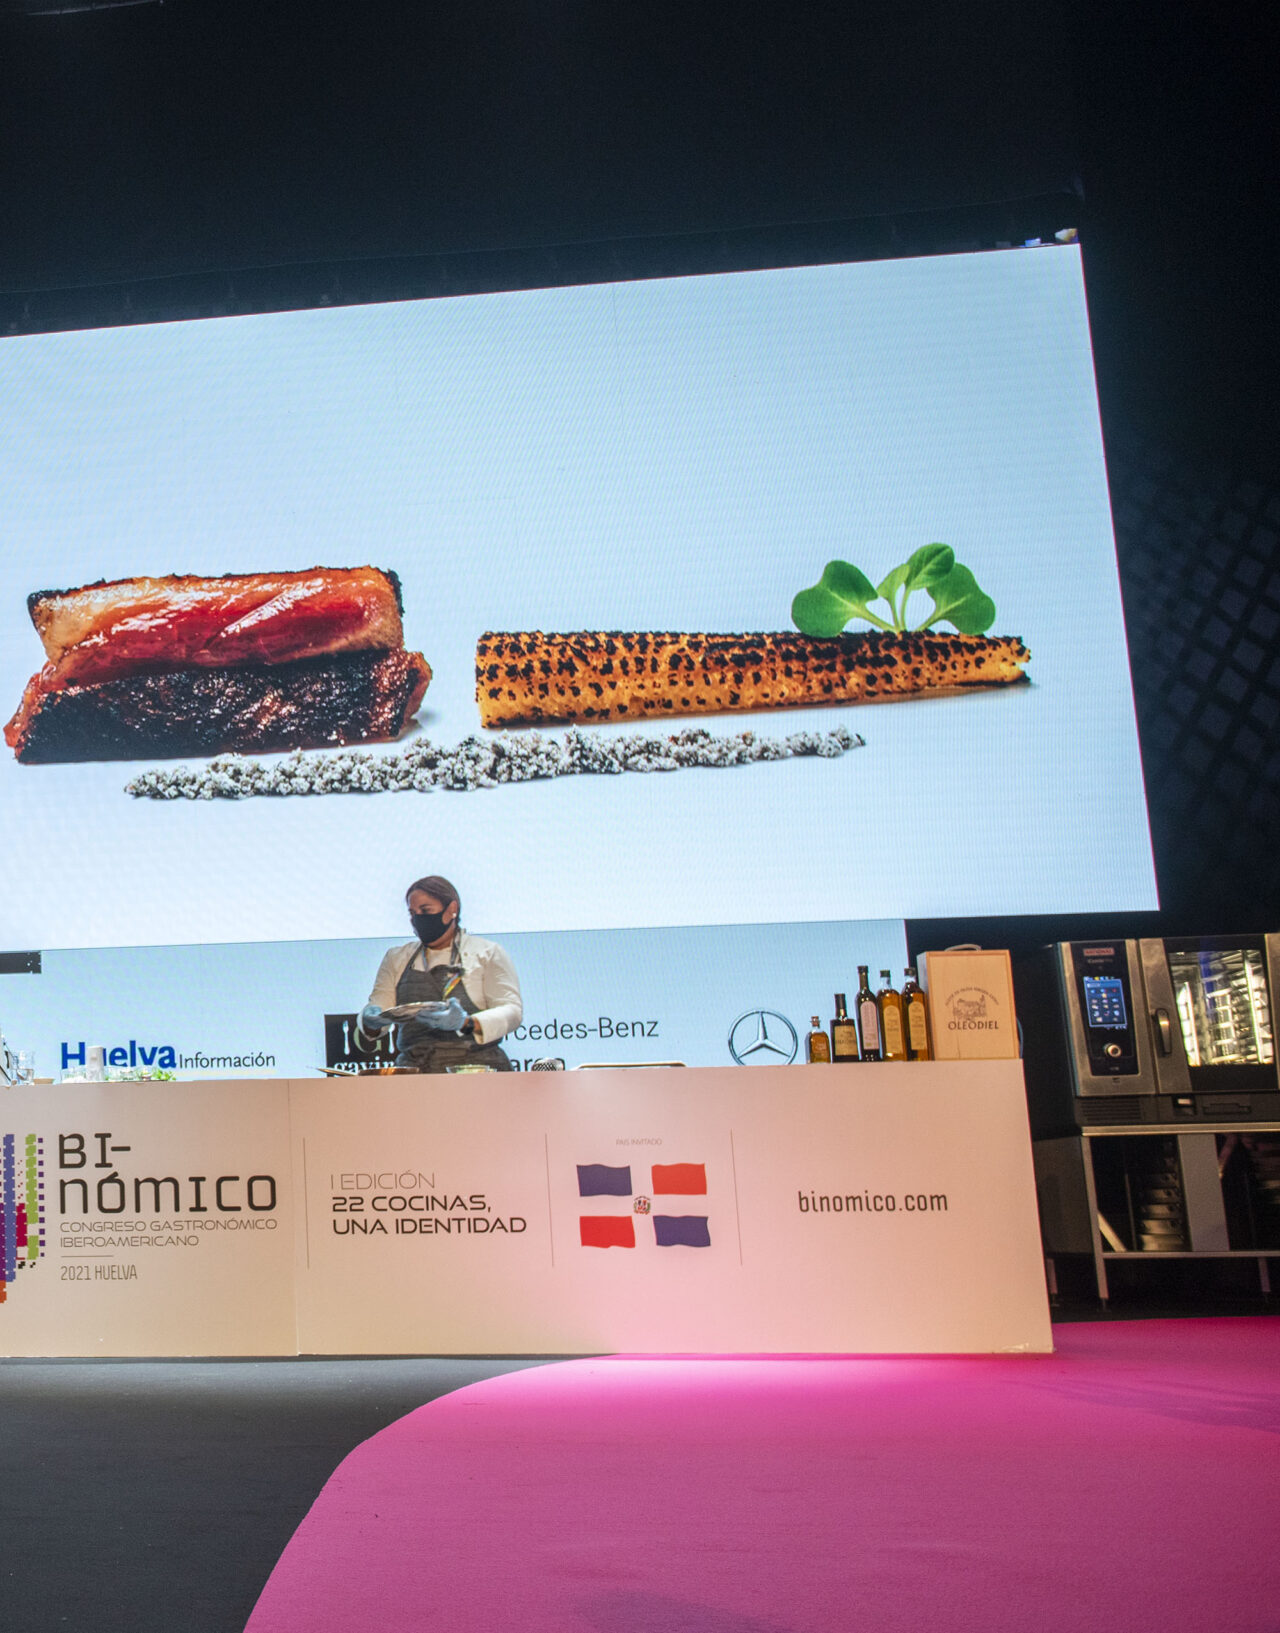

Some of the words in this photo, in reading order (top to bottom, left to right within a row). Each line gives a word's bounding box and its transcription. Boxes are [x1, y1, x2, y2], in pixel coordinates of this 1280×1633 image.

[947, 1020, 999, 1031] OLEODIEL
[61, 1040, 177, 1069] Helva
[179, 1052, 276, 1070] Información
[58, 1132, 131, 1170] BI-
[340, 1169, 436, 1190] EDICIÓN
[331, 1196, 365, 1213] 22
[370, 1194, 492, 1214] COCINAS,
[798, 1190, 949, 1214] binomico.com
[60, 1220, 146, 1233] CONGRESO
[149, 1217, 278, 1233] GASTRONÓMICO
[332, 1218, 388, 1235] UNA
[395, 1216, 527, 1235] IDENTIDAD
[60, 1234, 199, 1248] IBEROAMERICANO
[60, 1266, 91, 1281] 2021
[94, 1264, 138, 1281] HUELVA
